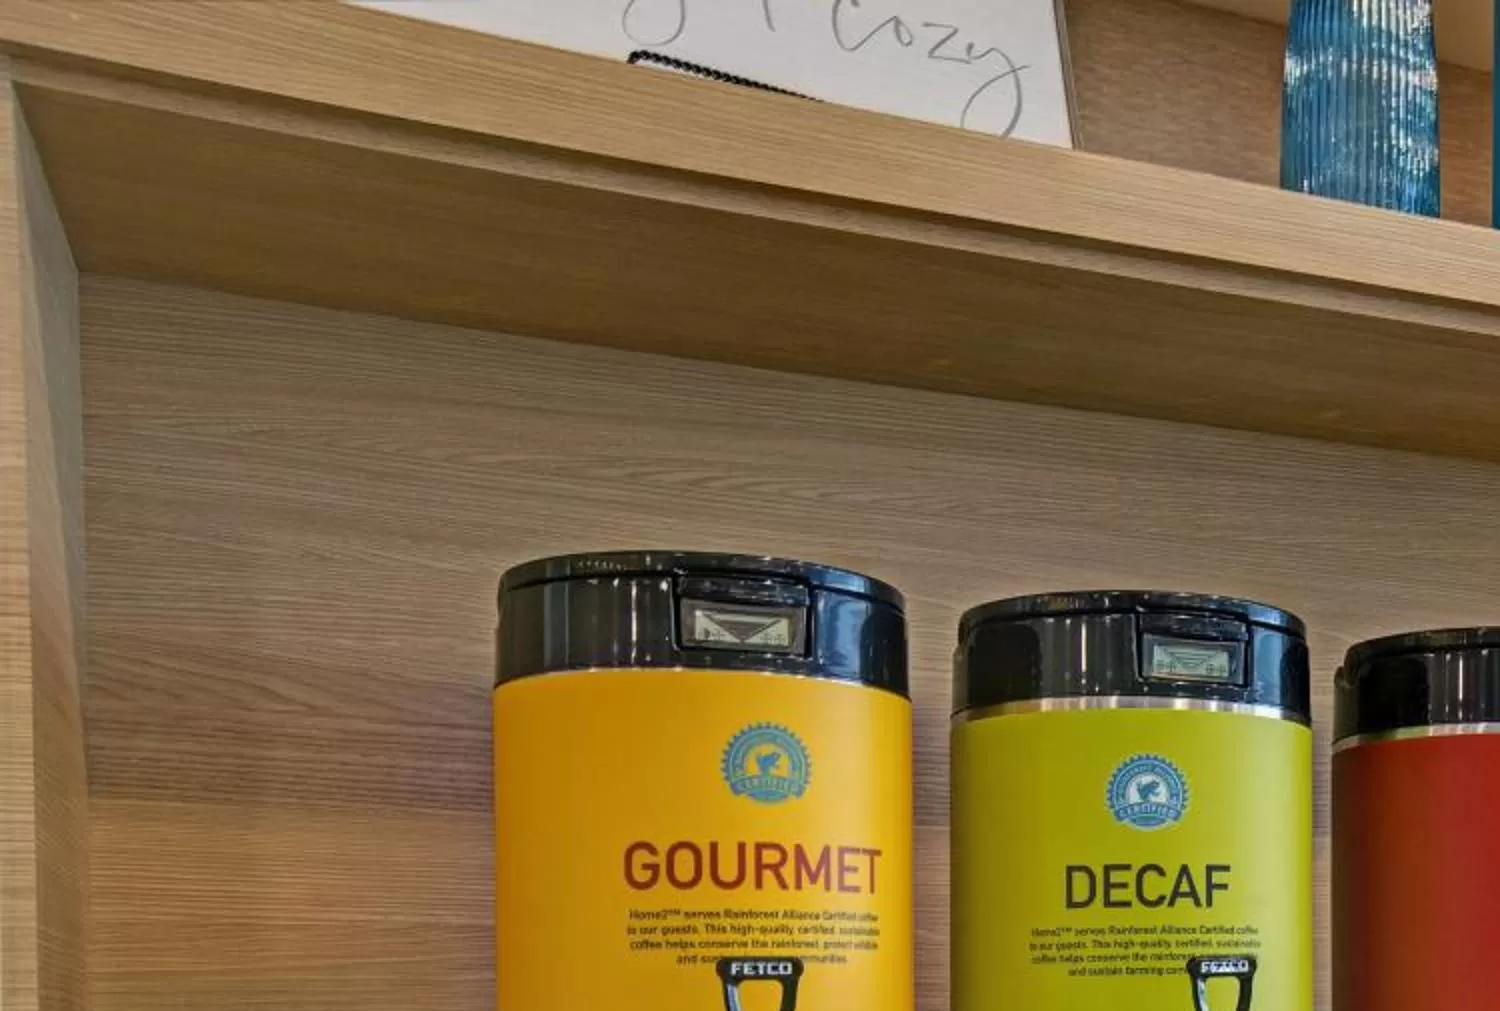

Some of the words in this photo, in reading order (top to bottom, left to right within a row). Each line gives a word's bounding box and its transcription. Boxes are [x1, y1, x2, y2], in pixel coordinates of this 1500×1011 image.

[623, 841, 882, 895] GOURMET
[1065, 863, 1231, 909] DECAF
[730, 961, 793, 975] FETCO
